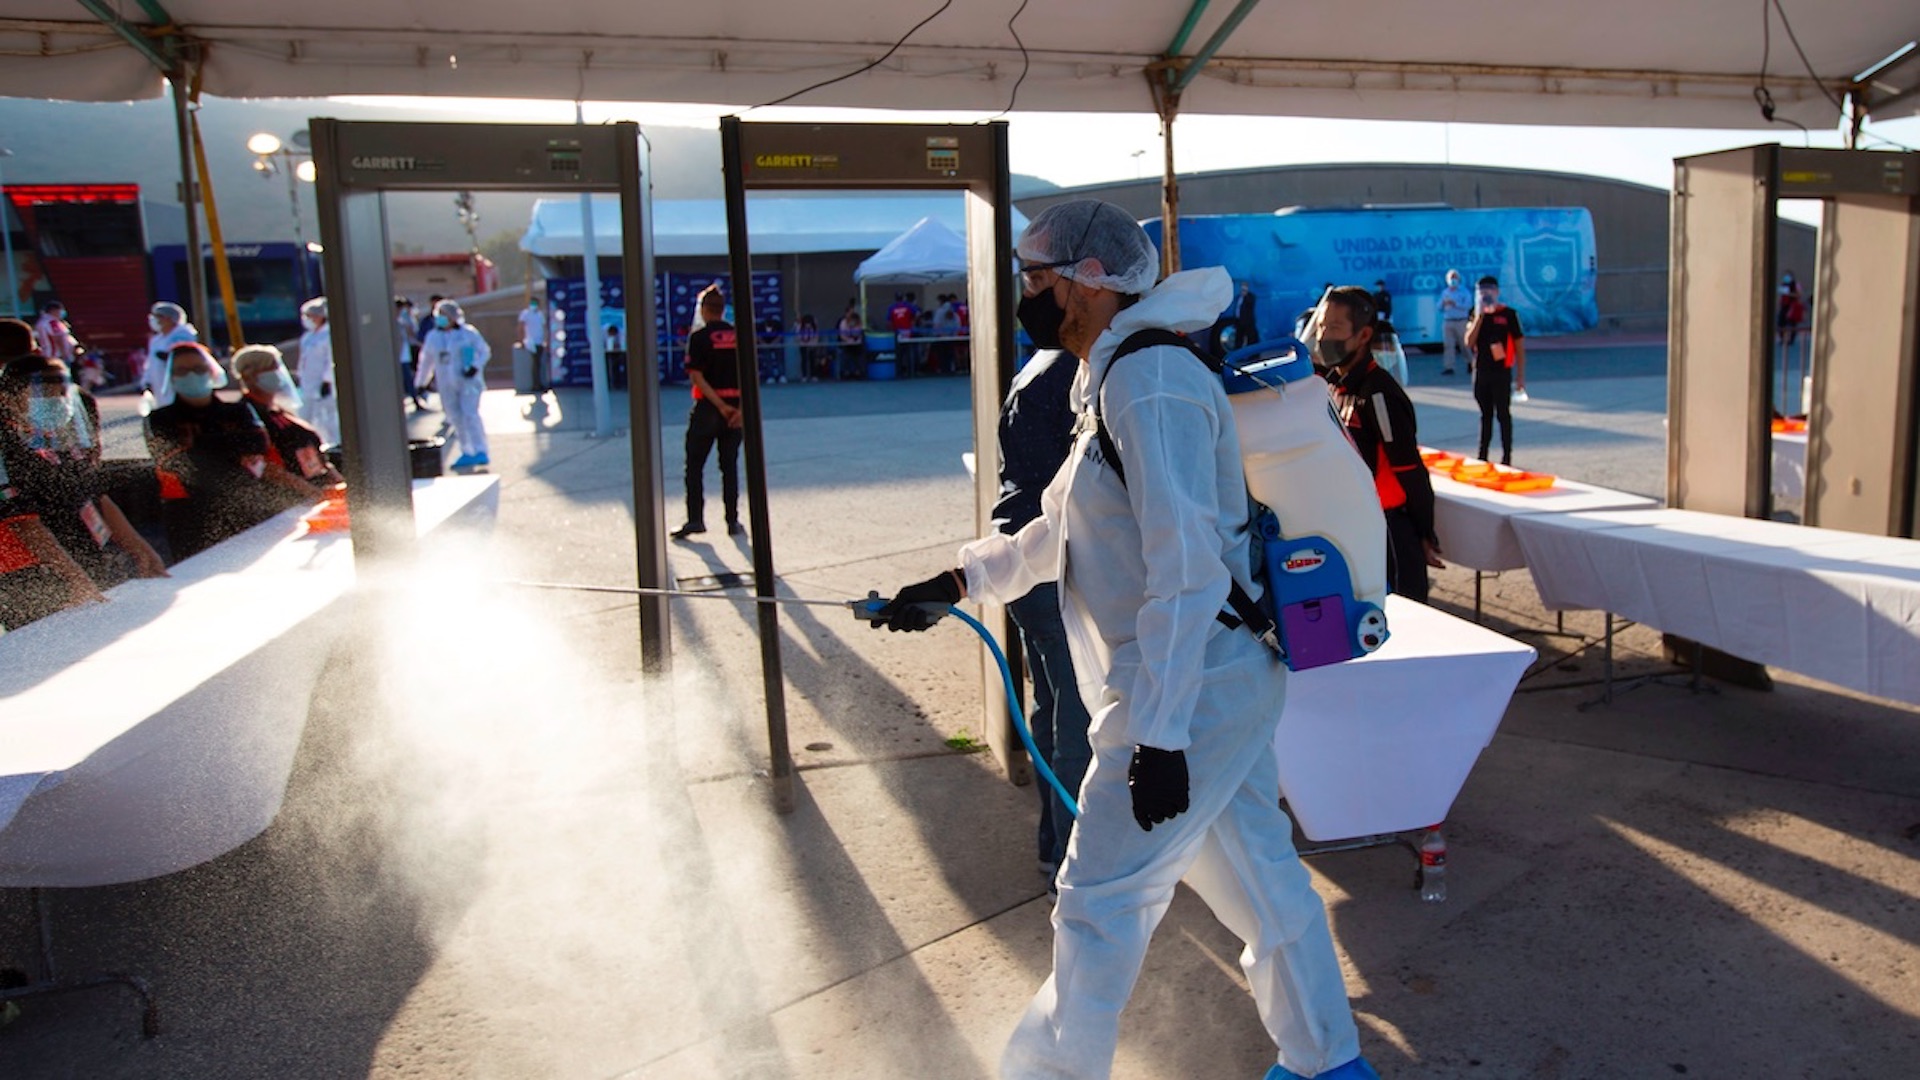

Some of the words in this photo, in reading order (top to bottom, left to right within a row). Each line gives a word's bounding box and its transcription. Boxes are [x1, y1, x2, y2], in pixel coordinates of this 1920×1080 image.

[351, 156, 415, 169] GARRETT
[756, 155, 812, 168] GARRETT
[1333, 236, 1402, 253] UNIDAD
[1405, 231, 1463, 250] MÓVIL
[1467, 236, 1506, 249] PARA
[1339, 255, 1398, 272] TOMA
[1422, 250, 1504, 268] PRUEBAS
